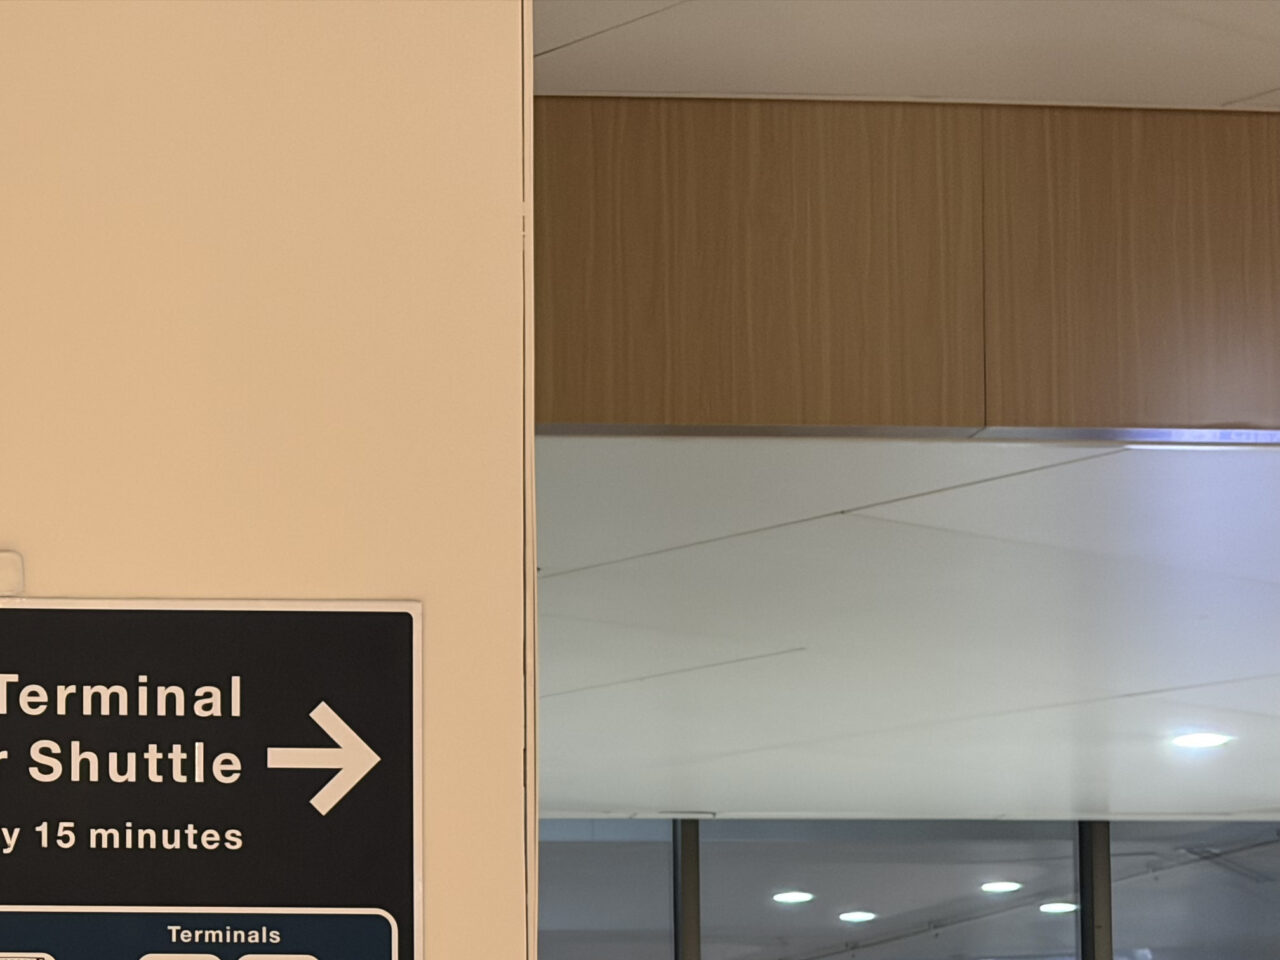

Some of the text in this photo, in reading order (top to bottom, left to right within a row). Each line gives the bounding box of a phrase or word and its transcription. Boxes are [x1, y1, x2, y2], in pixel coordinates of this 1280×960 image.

[28, 740, 242, 784] Shuttle
[34, 822, 76, 849] 15
[89, 823, 243, 850] minutes
[167, 925, 281, 944] Terminals
